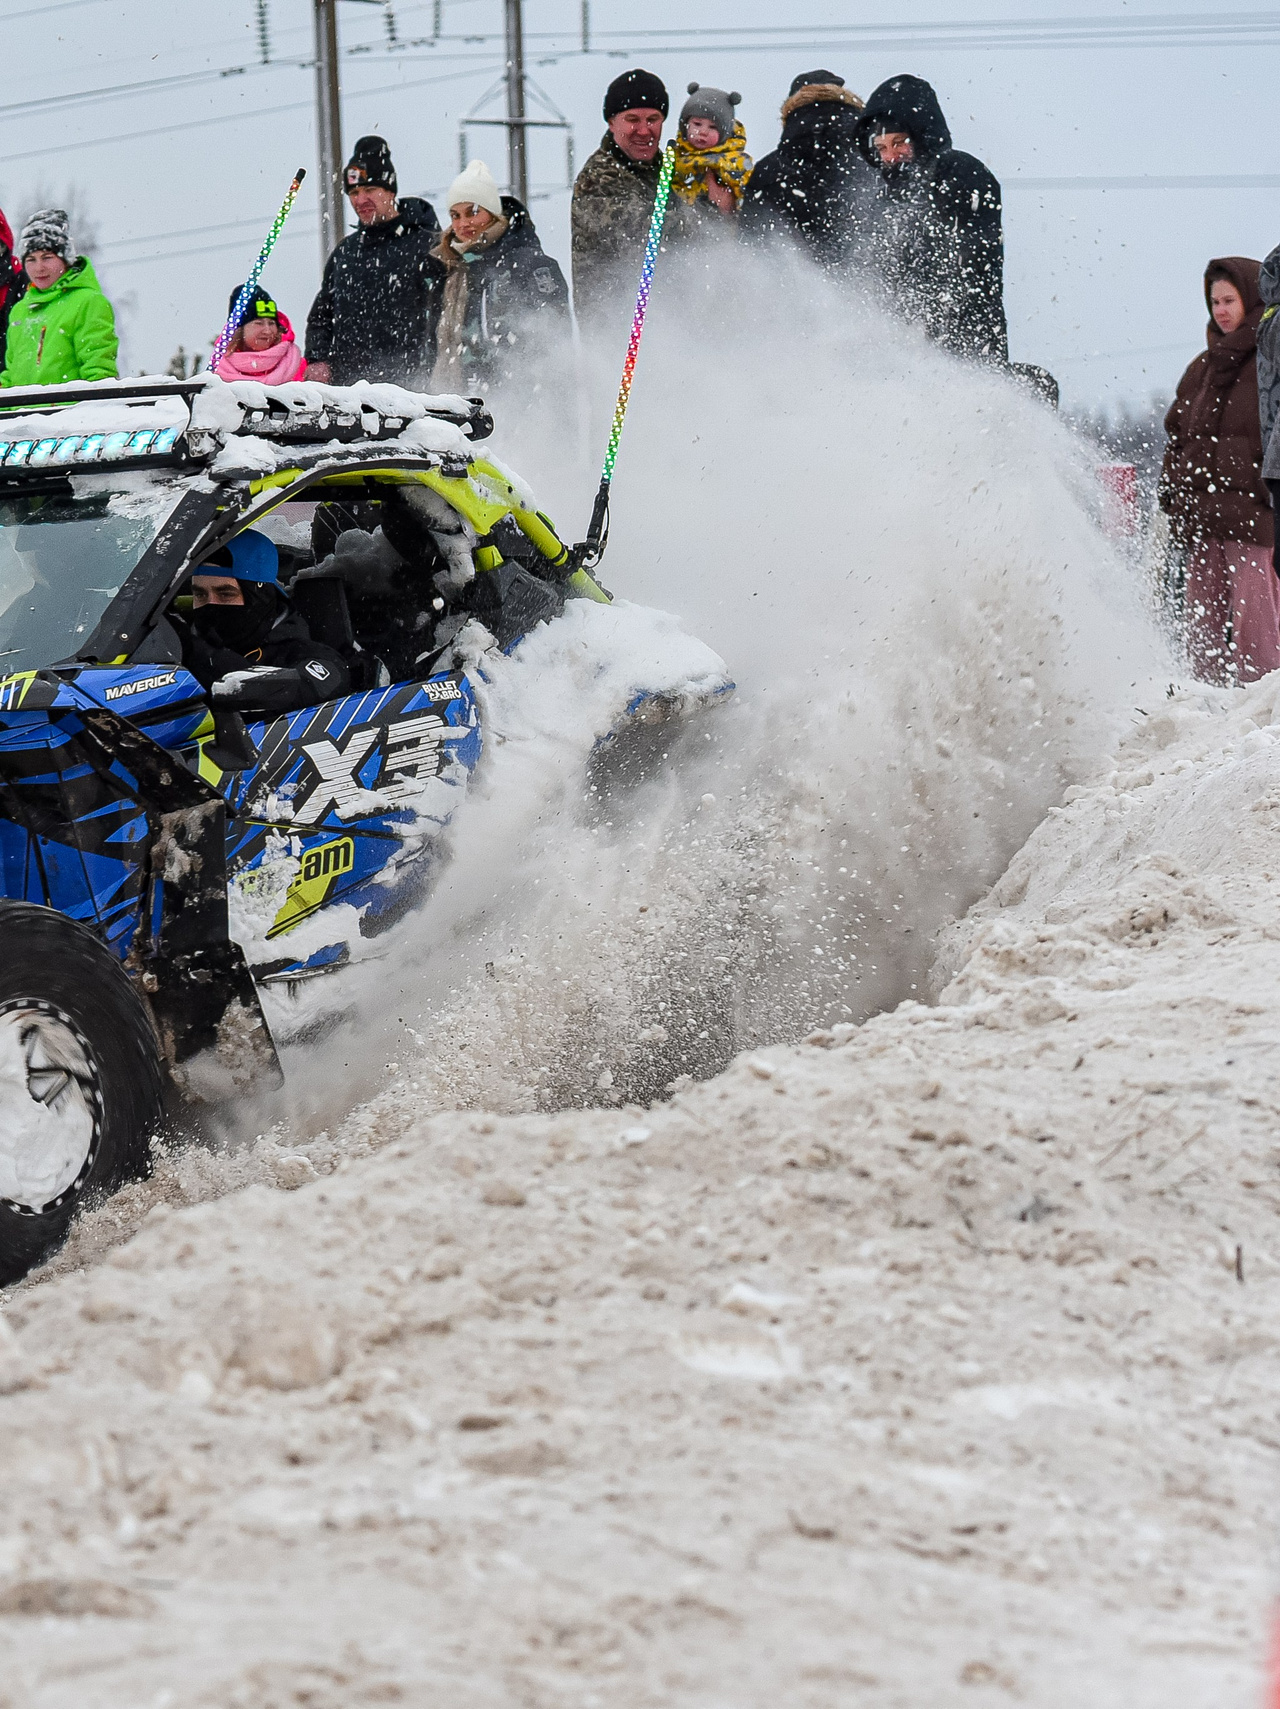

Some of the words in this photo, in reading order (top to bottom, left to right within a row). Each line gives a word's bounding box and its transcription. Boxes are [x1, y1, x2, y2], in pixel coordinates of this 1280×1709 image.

[105, 672, 176, 700] MAVERICK
[421, 681, 458, 694] BULLET
[290, 715, 444, 824] X3
